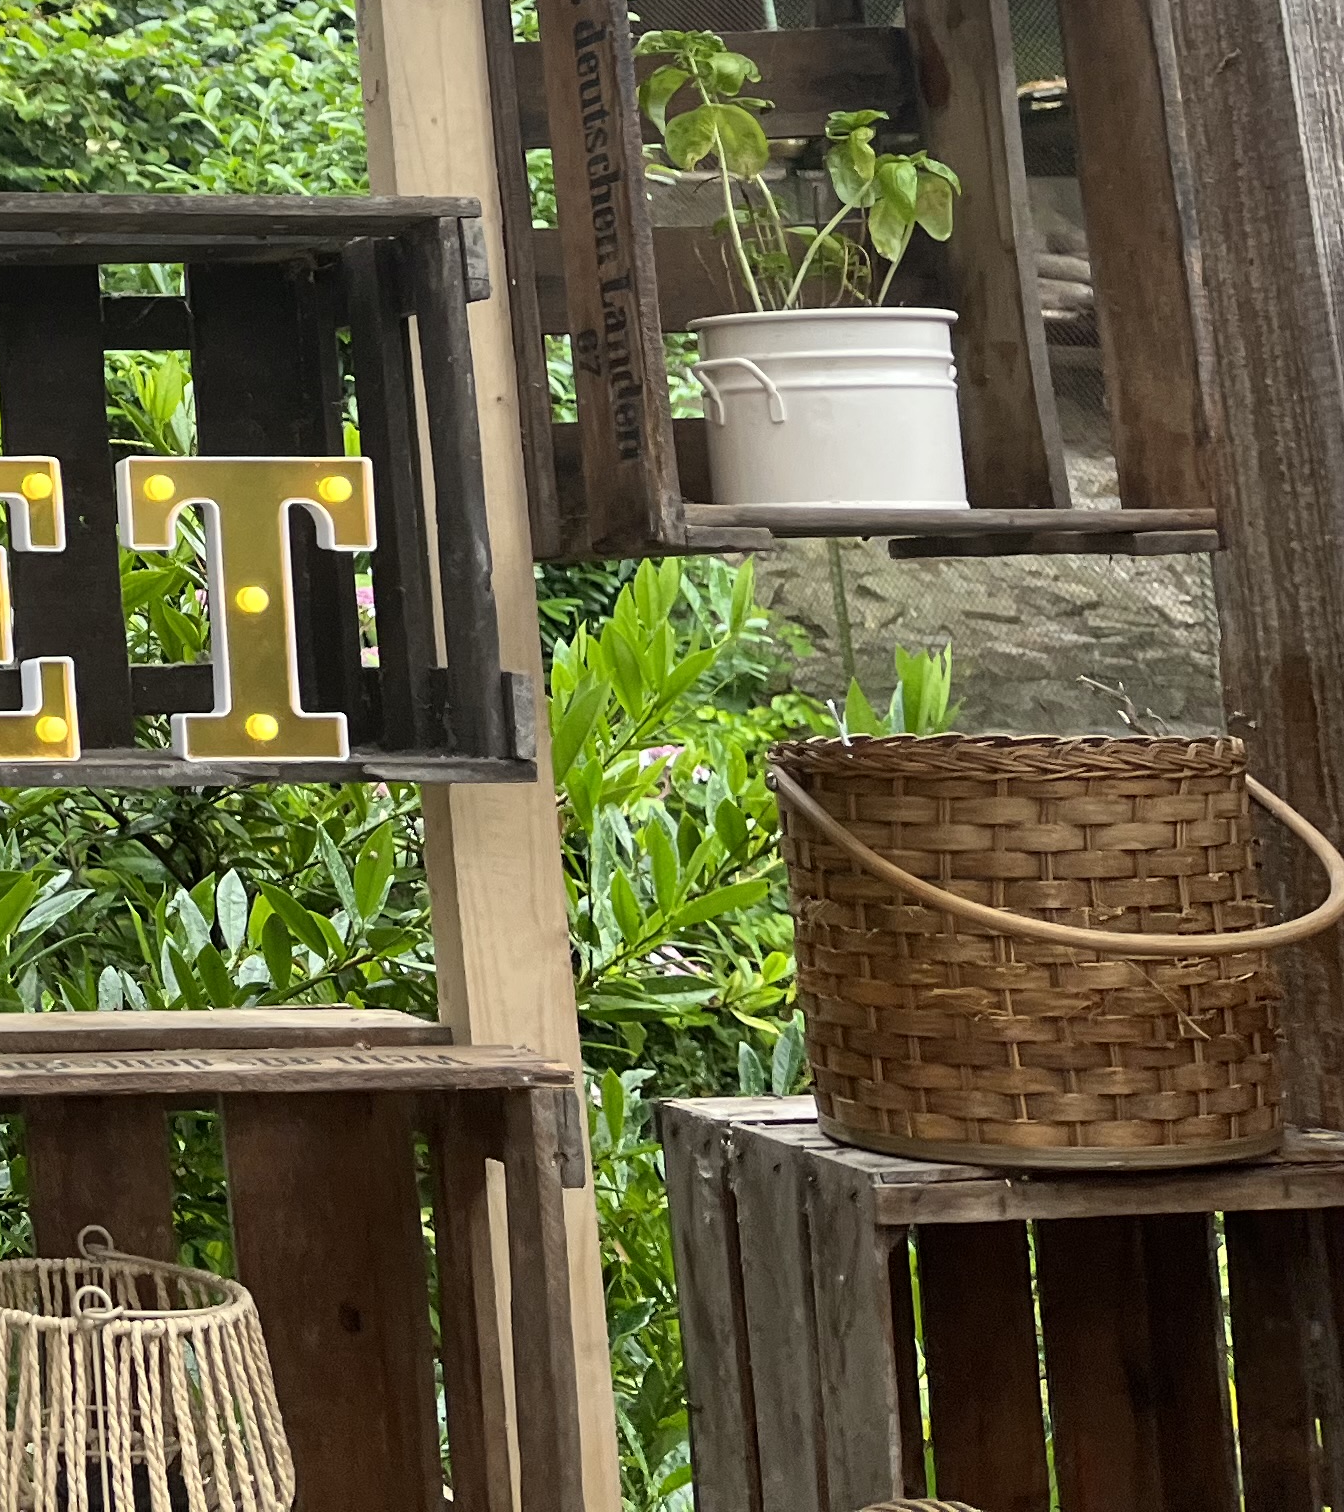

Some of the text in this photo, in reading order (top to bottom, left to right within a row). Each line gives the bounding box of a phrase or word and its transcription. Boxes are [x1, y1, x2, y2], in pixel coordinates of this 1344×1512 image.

[574, 19, 620, 268] deutschen
[600, 273, 644, 460] Landen
[332, 1054, 473, 1066] Wein
